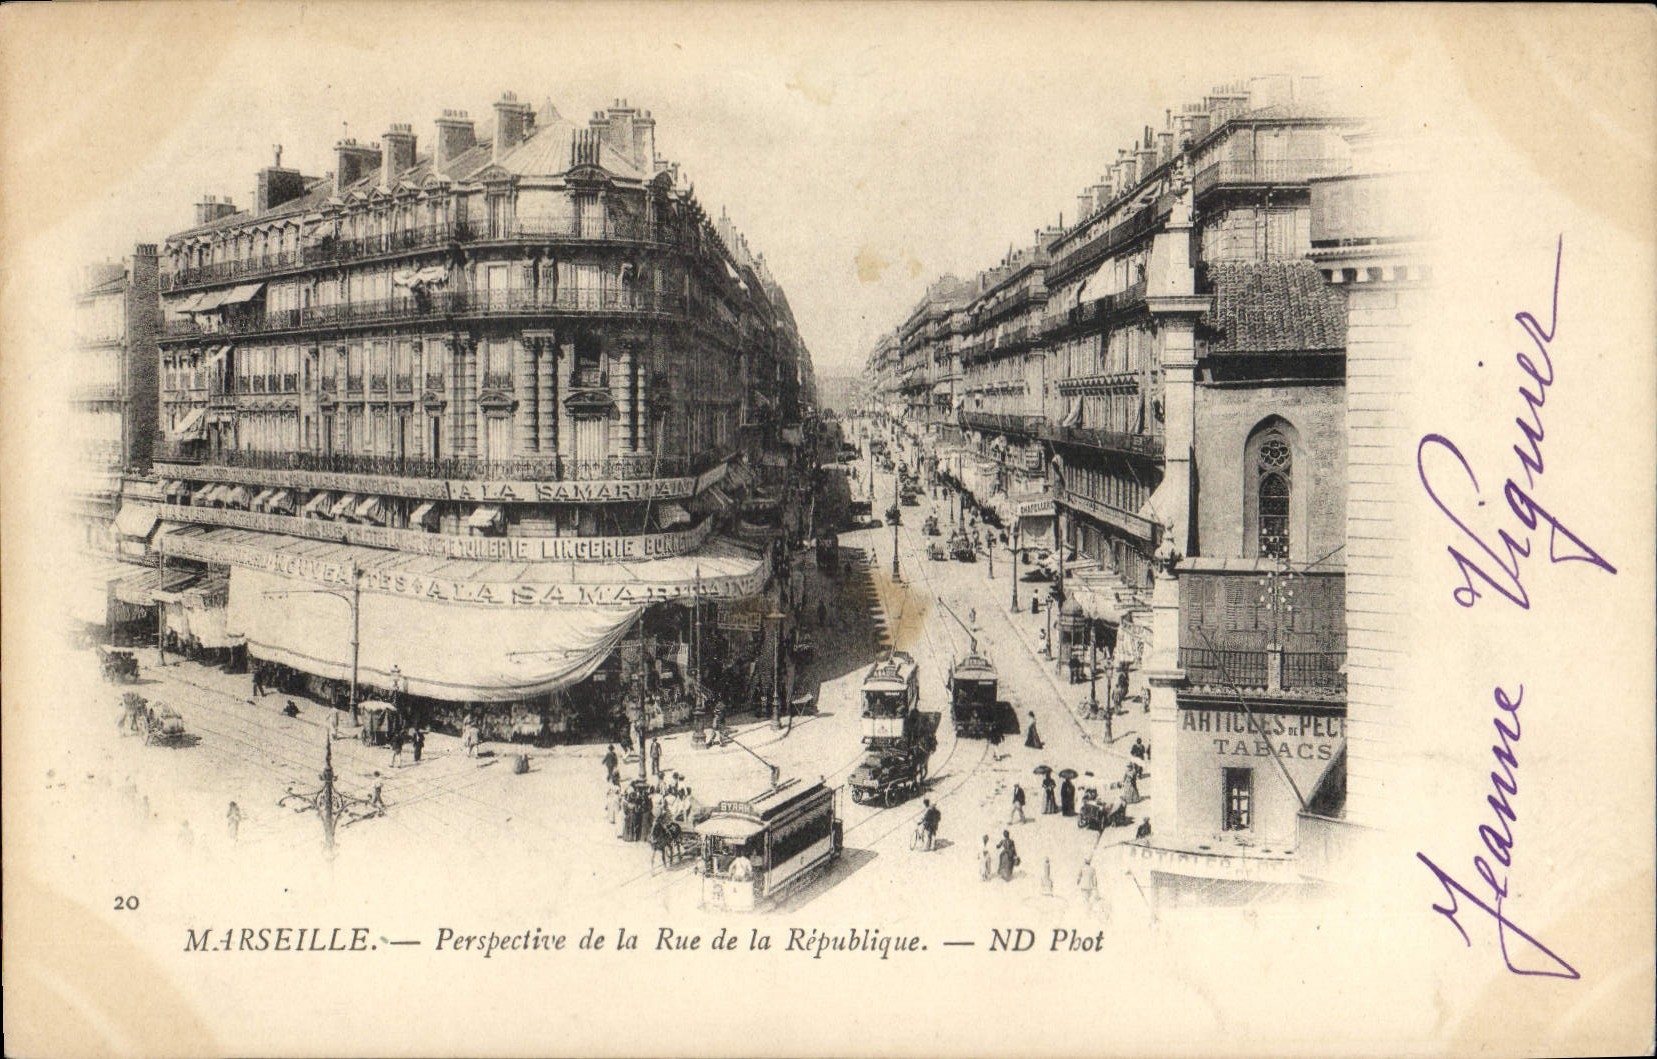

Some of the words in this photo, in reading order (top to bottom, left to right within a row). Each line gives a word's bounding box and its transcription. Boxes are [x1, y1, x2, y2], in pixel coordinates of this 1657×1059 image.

[458, 483, 477, 500] A
[541, 536, 634, 560] LINGERIE
[1288, 727, 1299, 737] DE
[1213, 739, 1332, 760] TABACS
[1417, 683, 1581, 980] Jeanne
